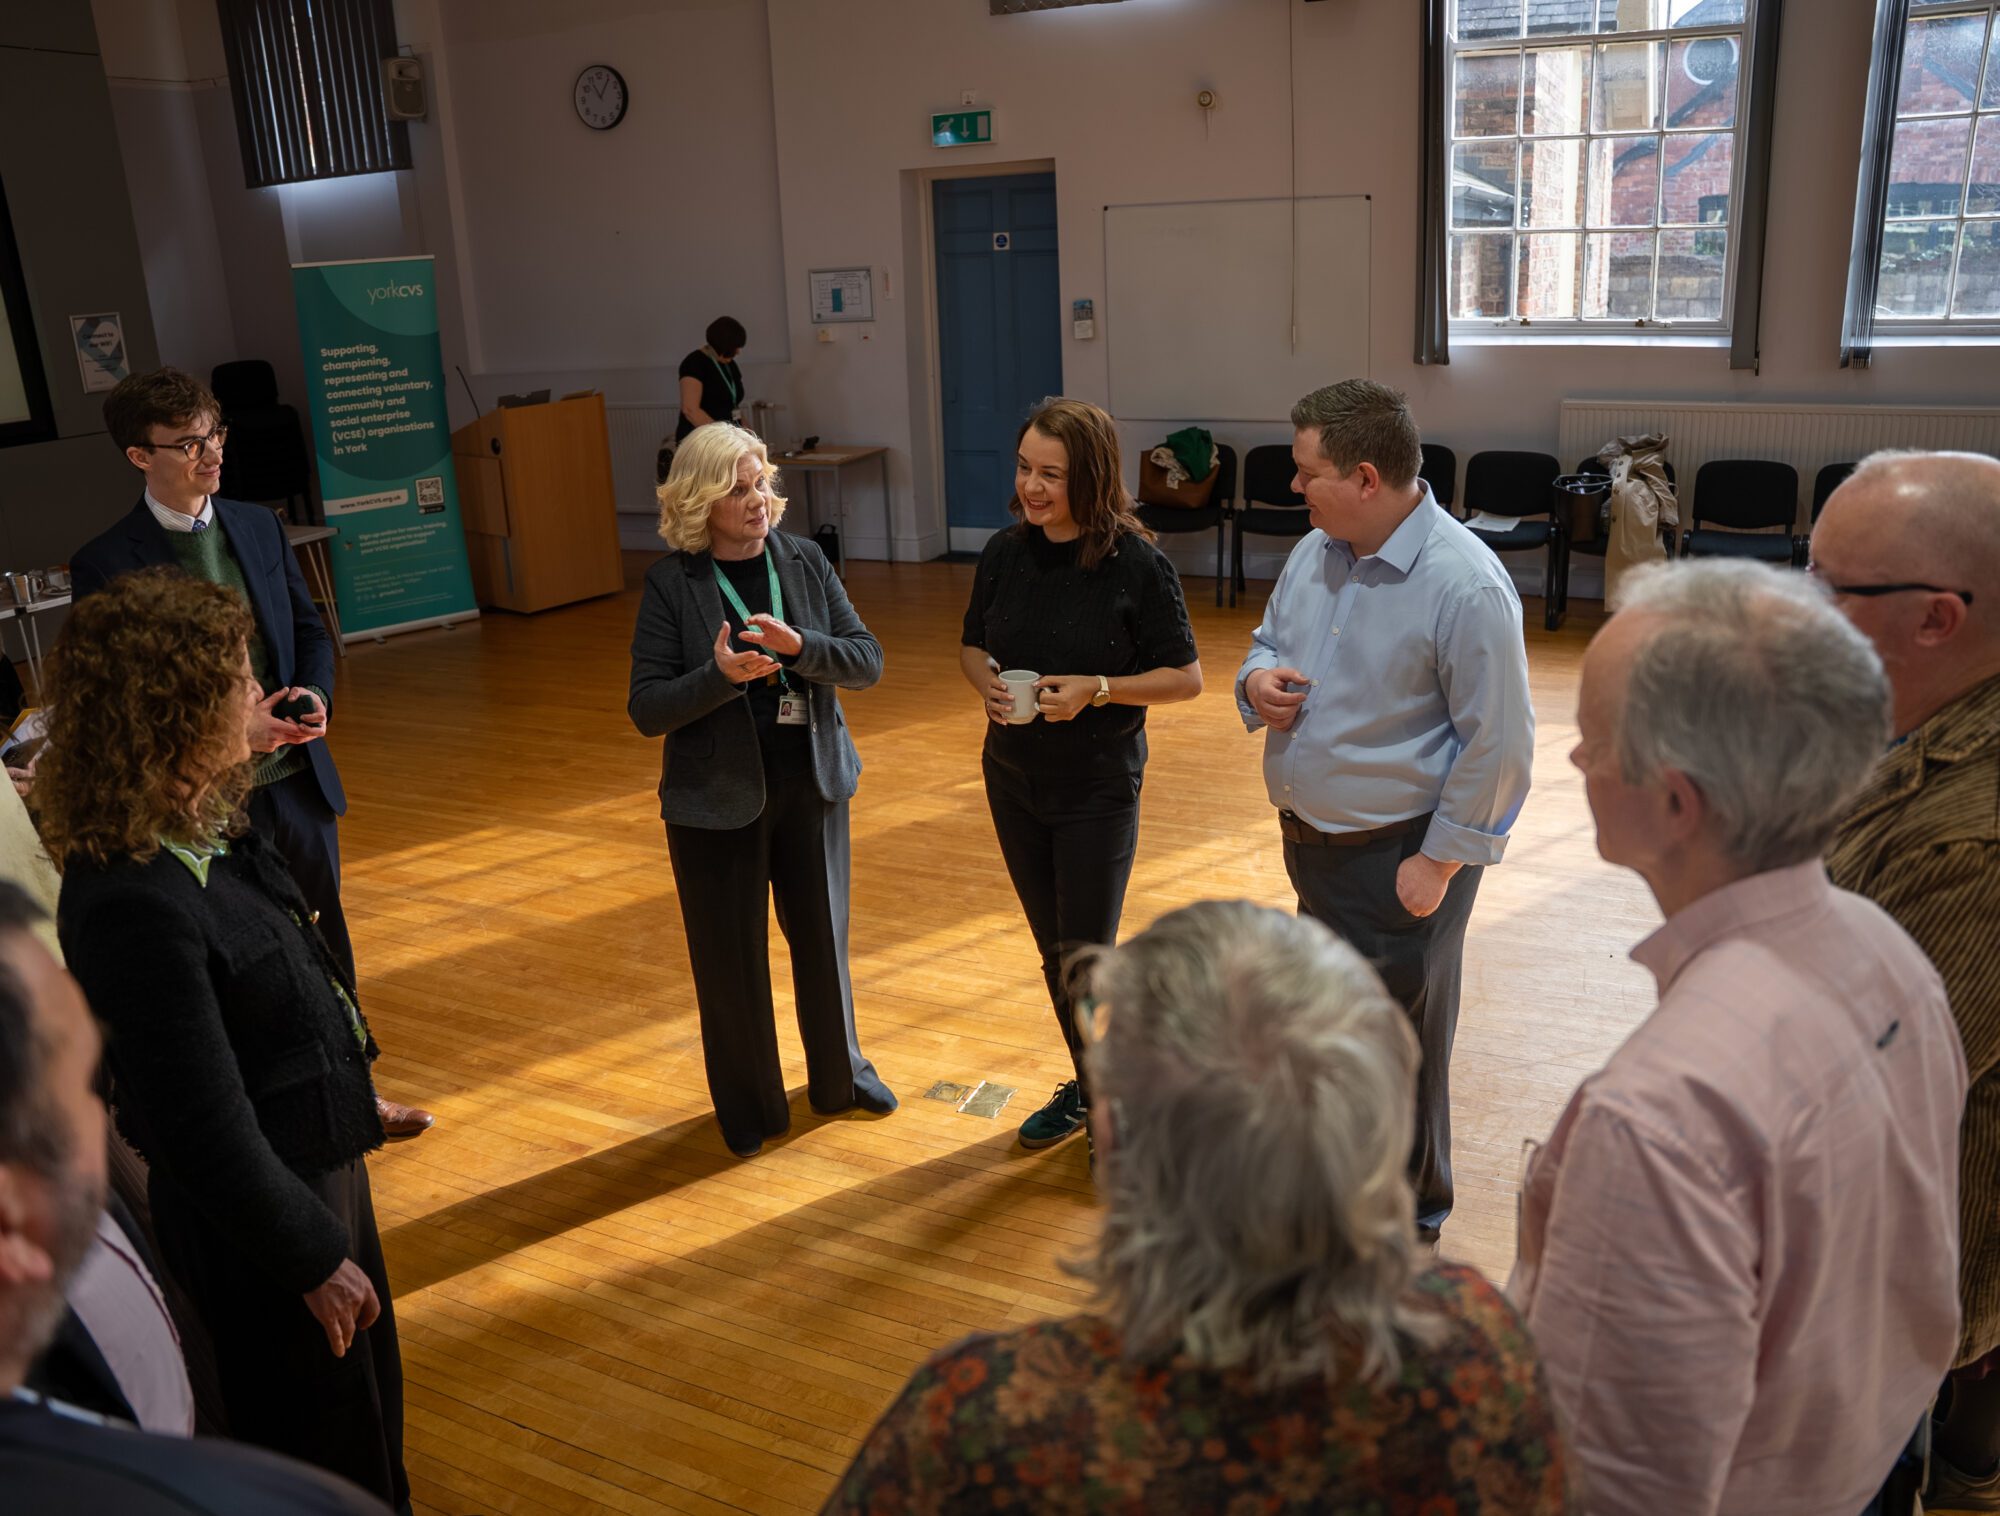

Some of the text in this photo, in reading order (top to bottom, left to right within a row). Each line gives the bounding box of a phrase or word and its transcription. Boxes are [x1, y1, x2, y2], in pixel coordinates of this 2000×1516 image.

[320, 344, 379, 358] Supporting,
[322, 357, 391, 372] championing,
[324, 368, 409, 386] representing and
[326, 380, 434, 400] connecting voluntary,
[328, 396, 406, 414] community and
[330, 410, 412, 428] social enterprise
[332, 421, 436, 443] (VCSE) organisations
[334, 443, 368, 455] in York
